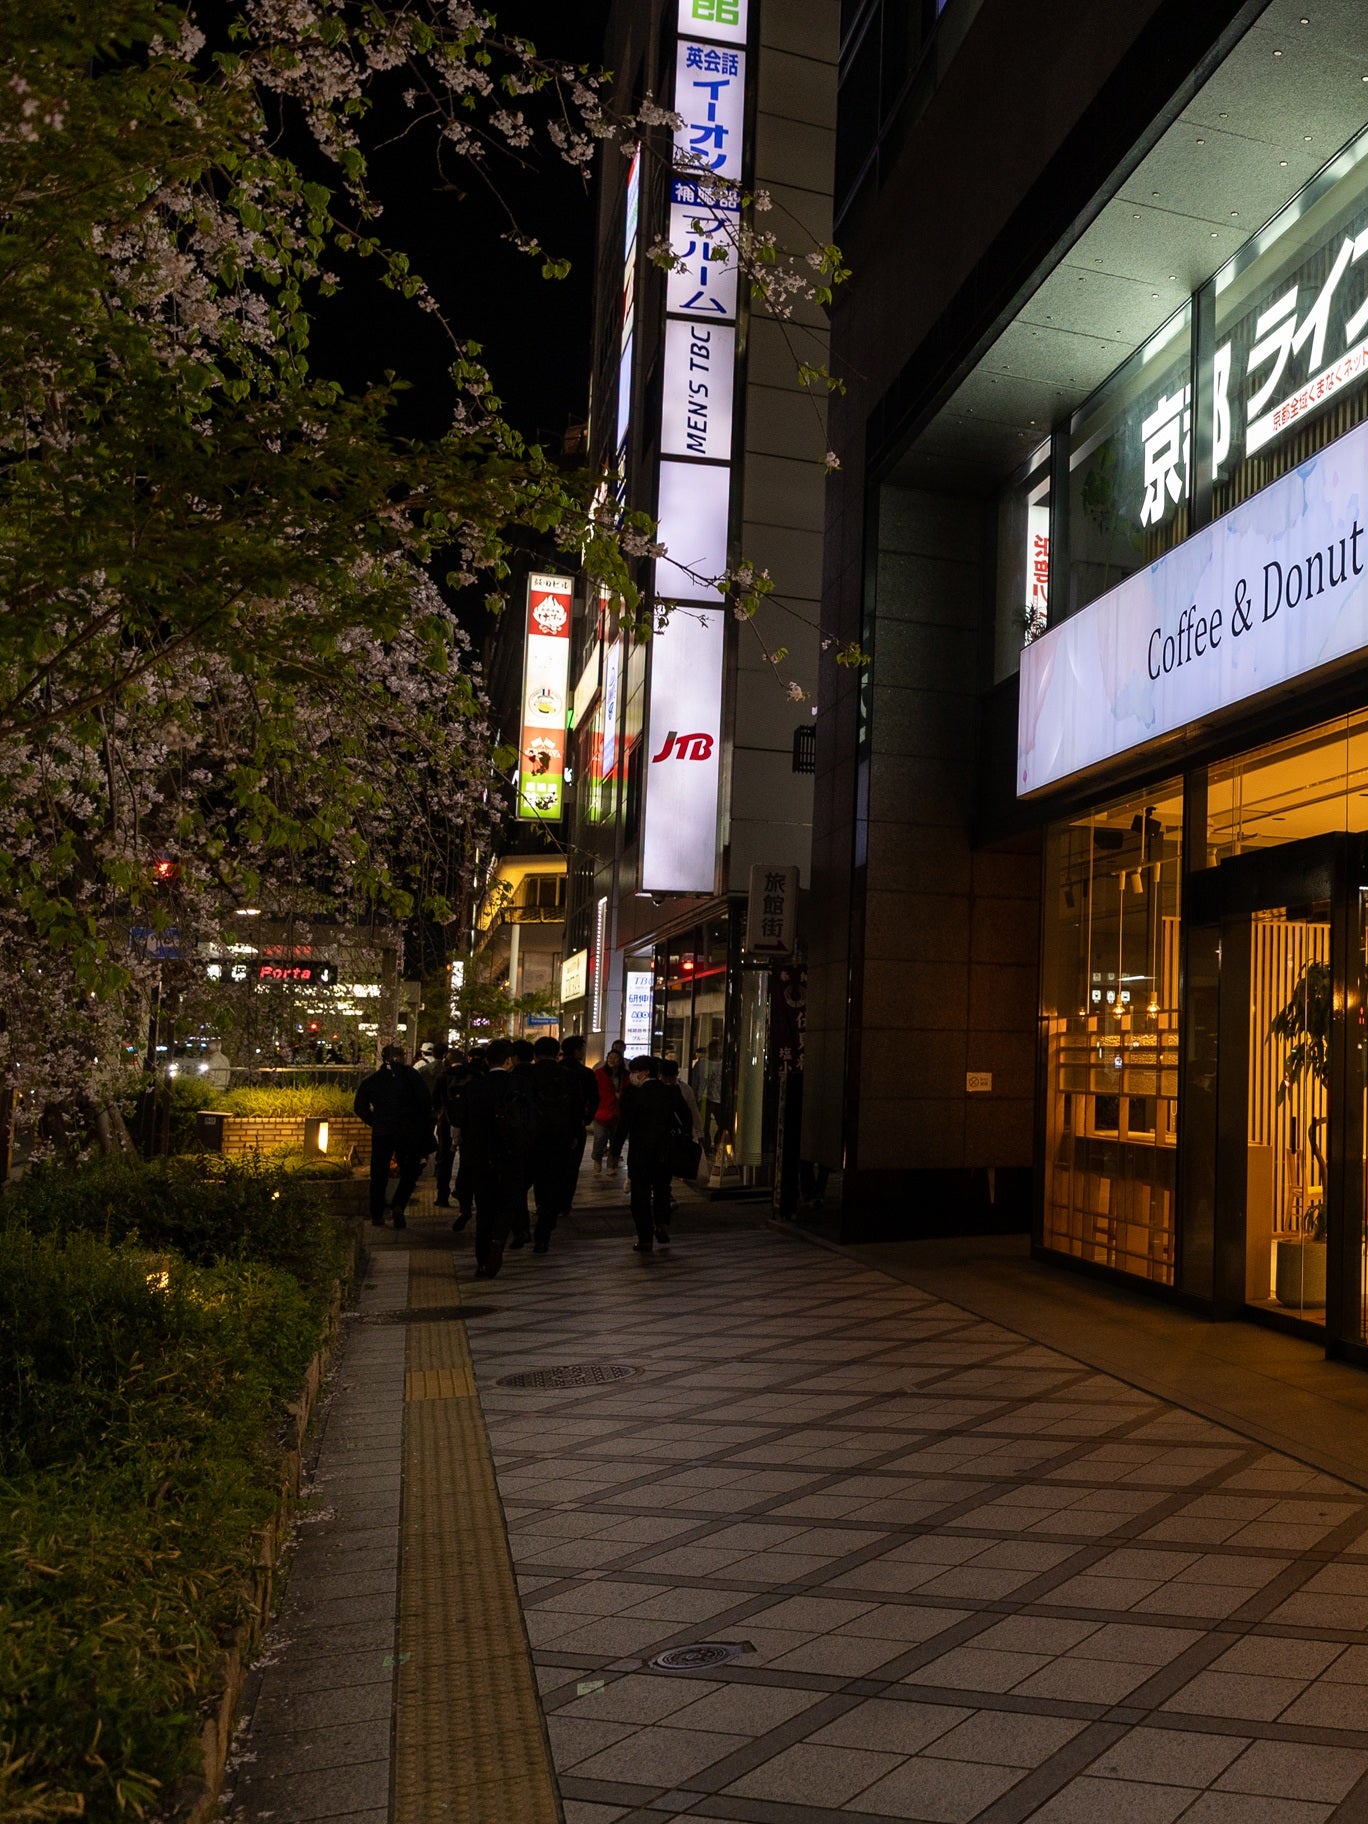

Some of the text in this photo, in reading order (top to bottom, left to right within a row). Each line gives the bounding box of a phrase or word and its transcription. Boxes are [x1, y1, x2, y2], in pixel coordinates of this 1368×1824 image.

[686, 46, 739, 77] 英会話
[689, 80, 730, 171] イーオン
[687, 326, 711, 454] MEN'S TBC
[1147, 520, 1364, 680] Coffee & Donut
[652, 731, 714, 763] JTB
[761, 871, 787, 938] 旅館街
[259, 965, 312, 980] Porta
[628, 994, 653, 1004] 研伸
